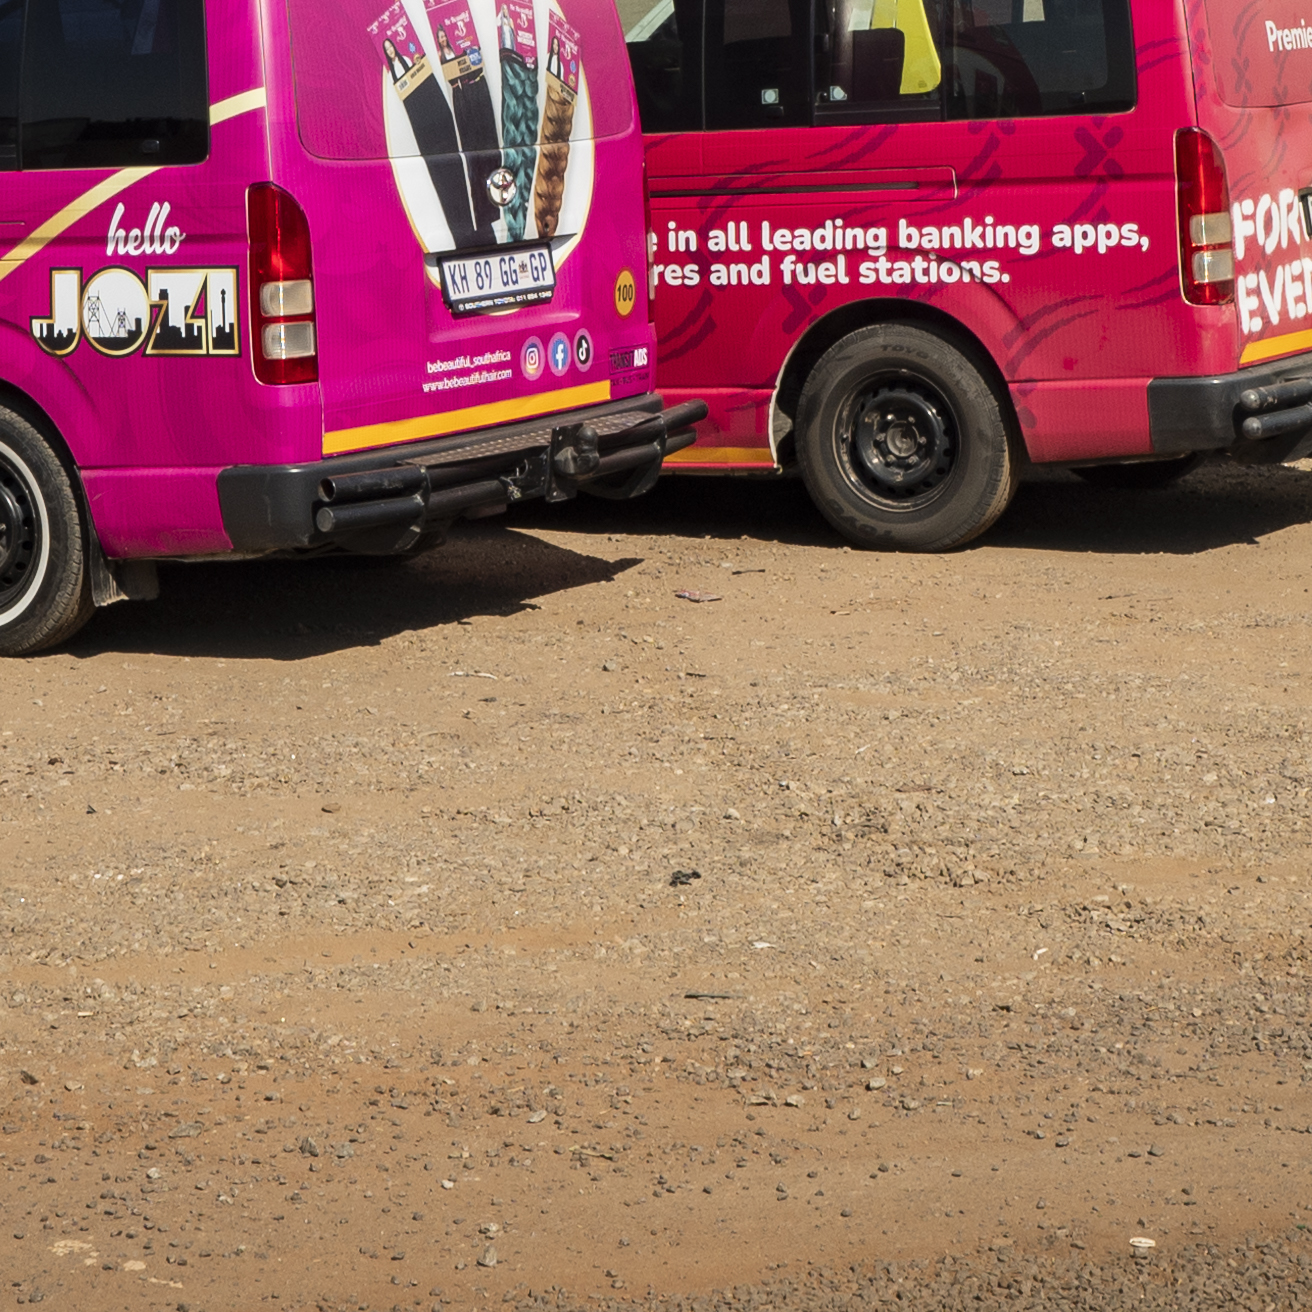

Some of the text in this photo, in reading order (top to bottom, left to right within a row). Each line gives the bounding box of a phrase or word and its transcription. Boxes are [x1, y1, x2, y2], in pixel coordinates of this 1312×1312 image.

[106, 201, 186, 257] hello
[668, 220, 697, 252] in
[707, 220, 751, 252] all
[761, 218, 887, 258] leading
[897, 216, 1040, 255] banking
[1051, 218, 1150, 254] apps,
[448, 252, 547, 295] KH 89 GG GP
[653, 254, 1011, 286] res and fuel stations.
[616, 283, 634, 302] 100
[426, 349, 511, 374] bebeautiful_southafrica
